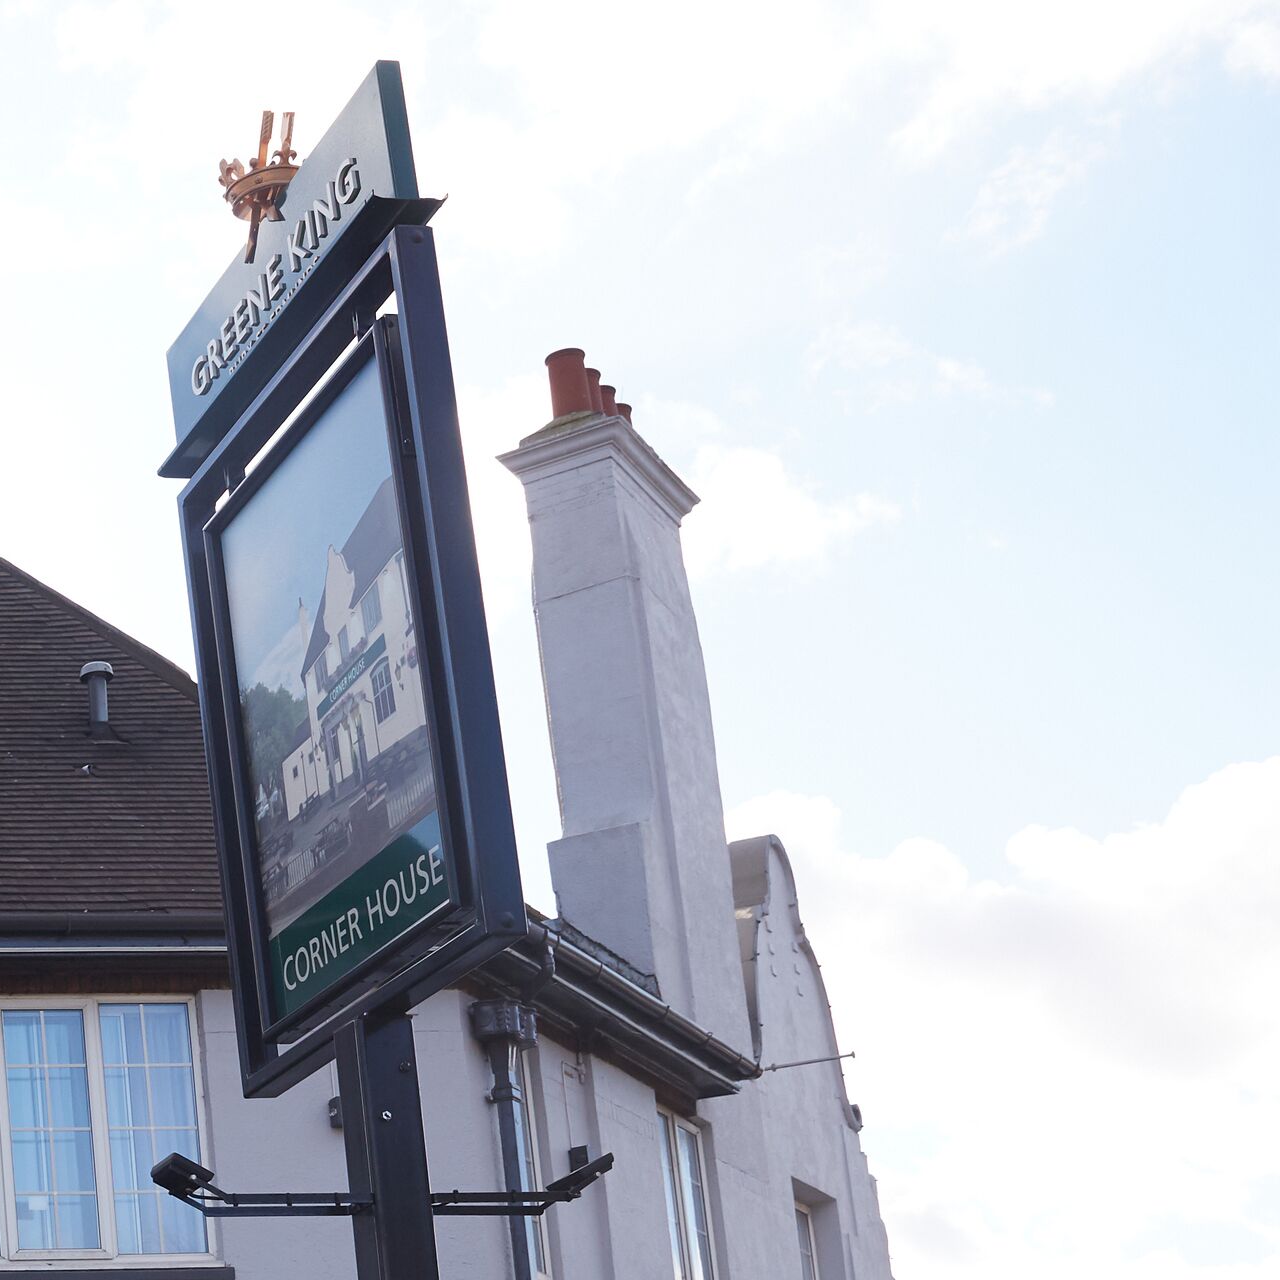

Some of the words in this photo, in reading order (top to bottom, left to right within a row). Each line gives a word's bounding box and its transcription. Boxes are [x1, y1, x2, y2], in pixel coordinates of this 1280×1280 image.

[191, 253, 287, 396] GREENE
[286, 157, 361, 274] KING
[283, 907, 363, 991] CORNER
[366, 844, 444, 932] HOUSE
